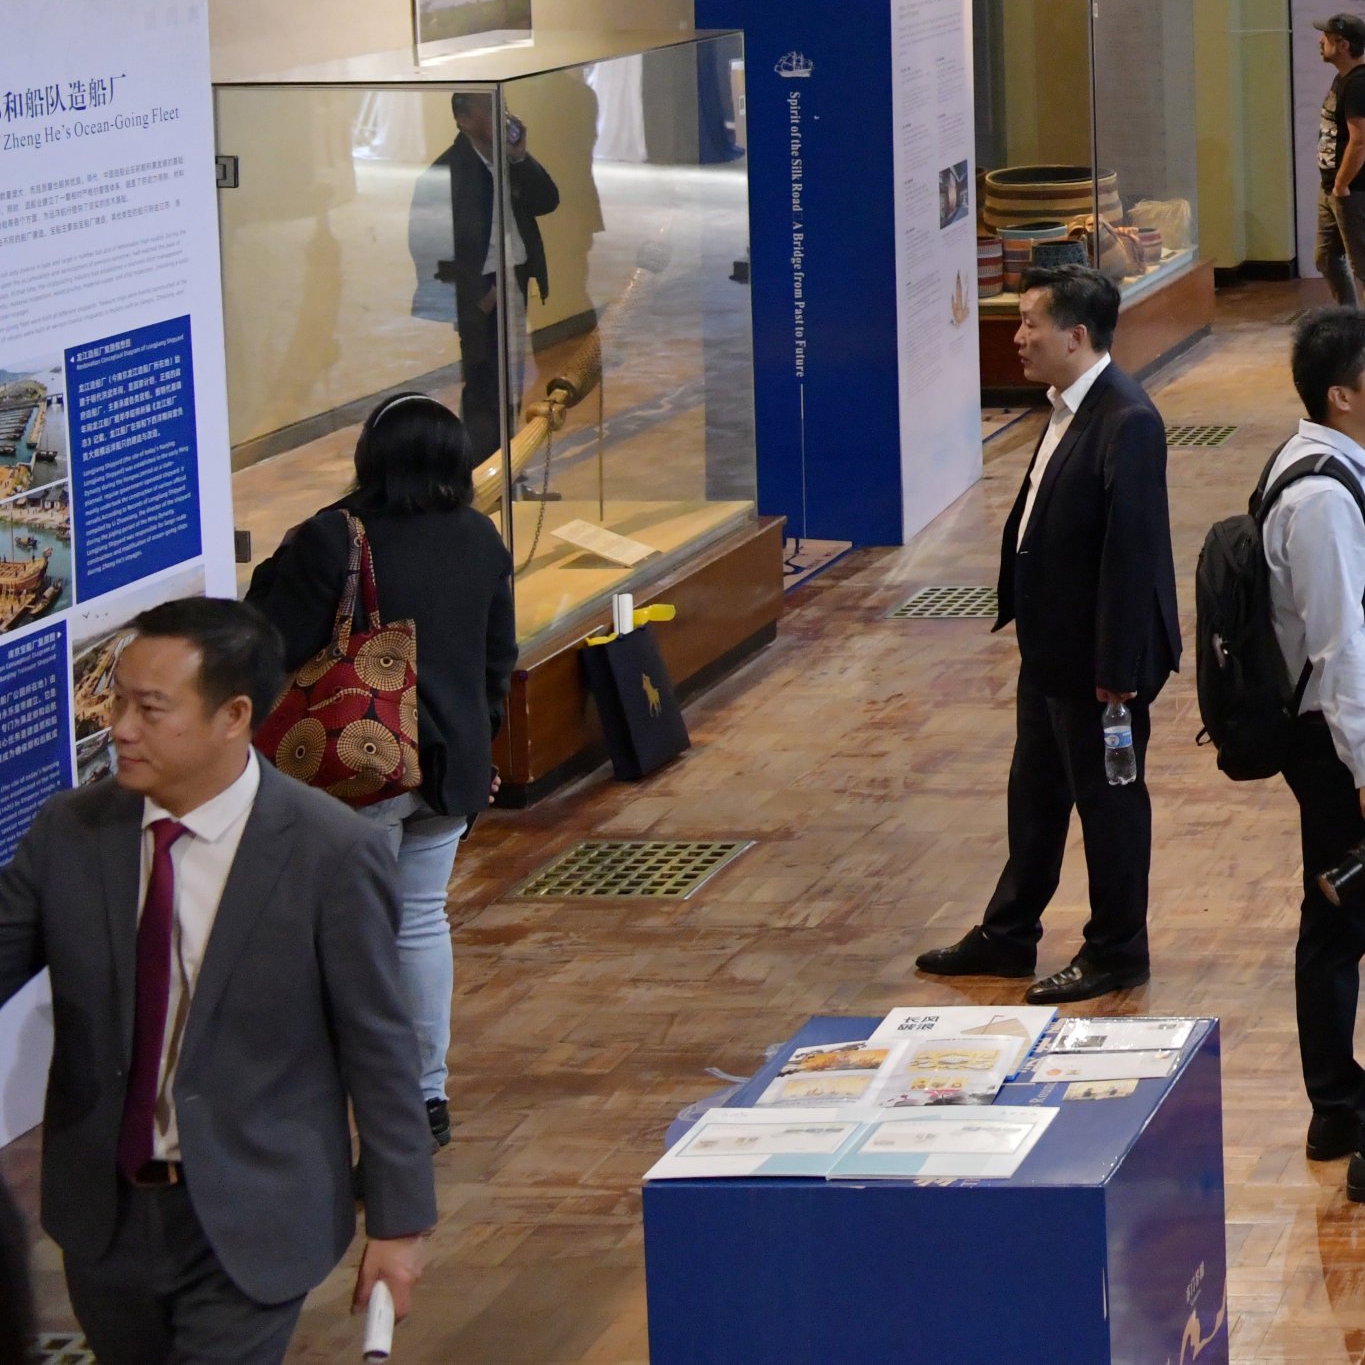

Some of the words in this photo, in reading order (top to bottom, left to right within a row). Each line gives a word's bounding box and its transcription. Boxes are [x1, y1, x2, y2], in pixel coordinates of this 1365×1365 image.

[0, 73, 127, 123] 和船队造船厂
[786, 91, 801, 123] Spirit
[3, 132, 42, 152] Zheng
[74, 111, 149, 138] Ocean-Going
[151, 106, 180, 125] Fleet
[788, 125, 801, 136] of
[788, 138, 802, 156] the
[789, 157, 803, 179] Silk
[791, 221, 804, 230] A
[791, 232, 805, 269] Bridge
[792, 271, 805, 298] from
[793, 301, 806, 329] Past
[794, 340, 807, 377] Future
